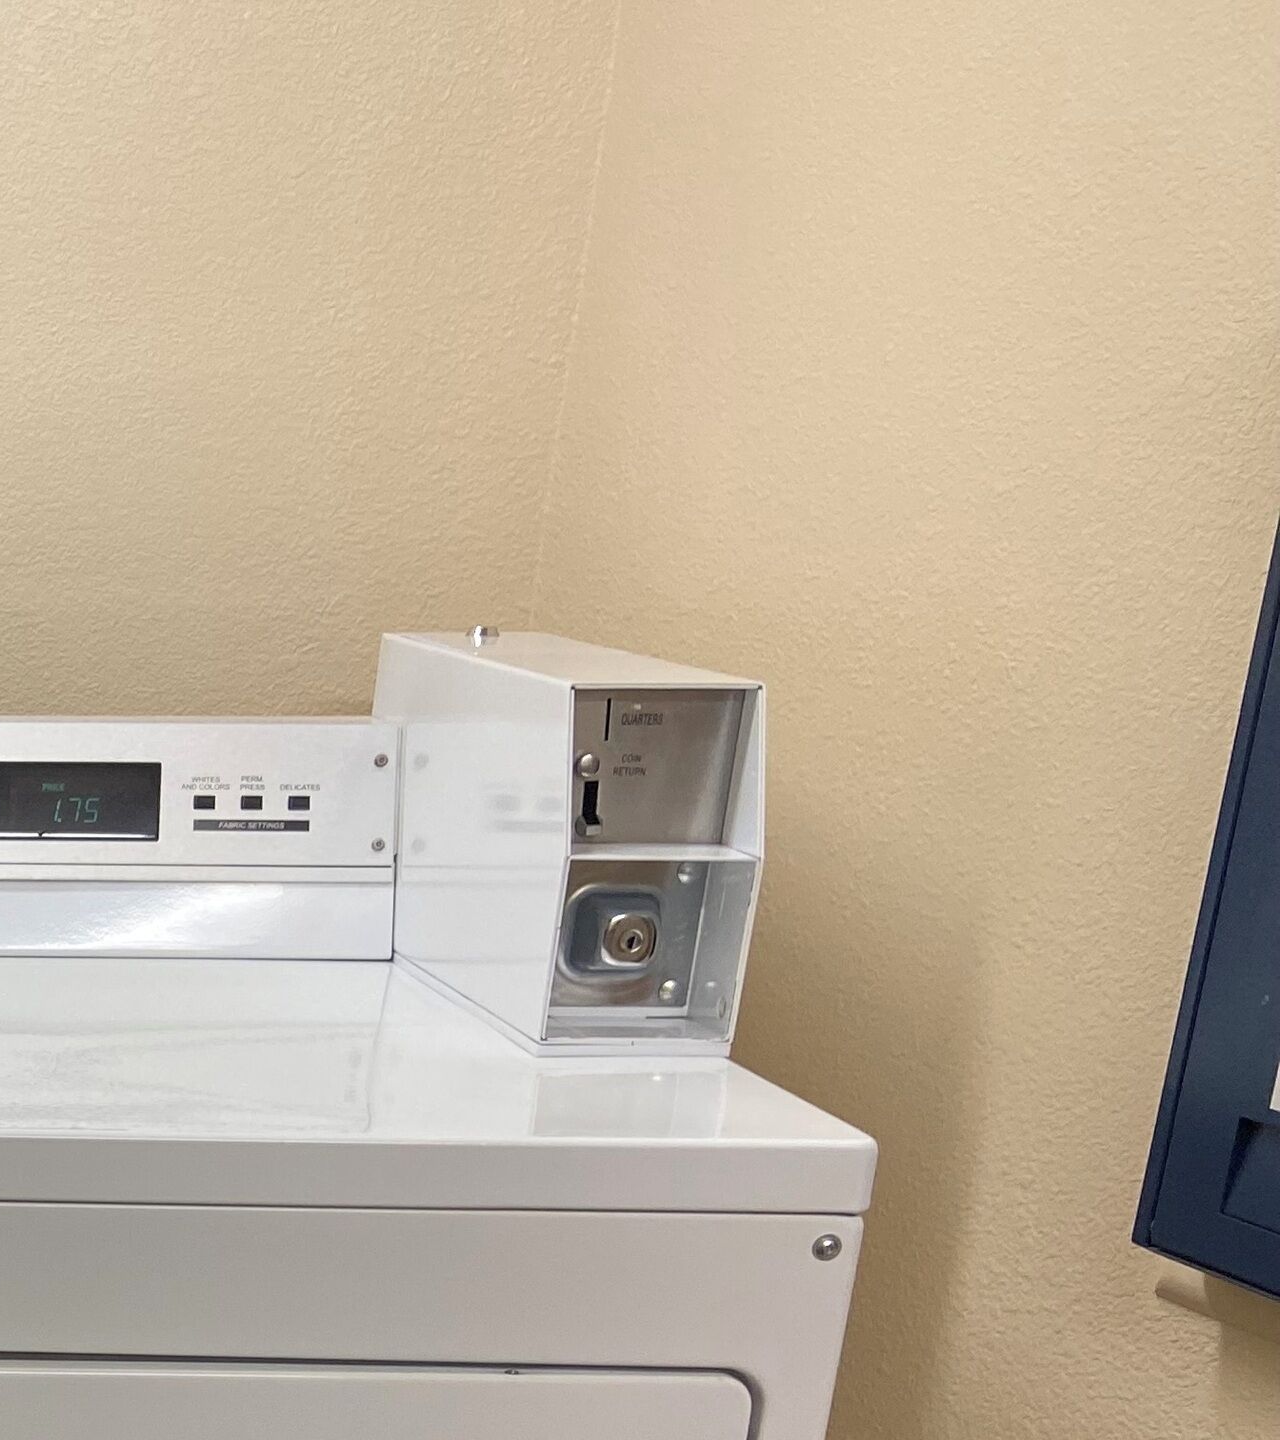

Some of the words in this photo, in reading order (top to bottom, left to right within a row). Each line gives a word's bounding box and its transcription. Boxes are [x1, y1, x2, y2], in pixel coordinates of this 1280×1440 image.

[621, 713, 663, 726] QUARTERS
[621, 754, 642, 763] COIN
[612, 766, 648, 777] RETURN
[191, 776, 221, 784] WHITES
[180, 783, 198, 791] AND
[199, 783, 231, 791] COLORS
[239, 783, 266, 791] PRESS
[279, 783, 321, 791] DELICATES
[53, 797, 101, 824] 1.75
[218, 821, 248, 830] FABRIC
[249, 821, 286, 830] SETTINGS
